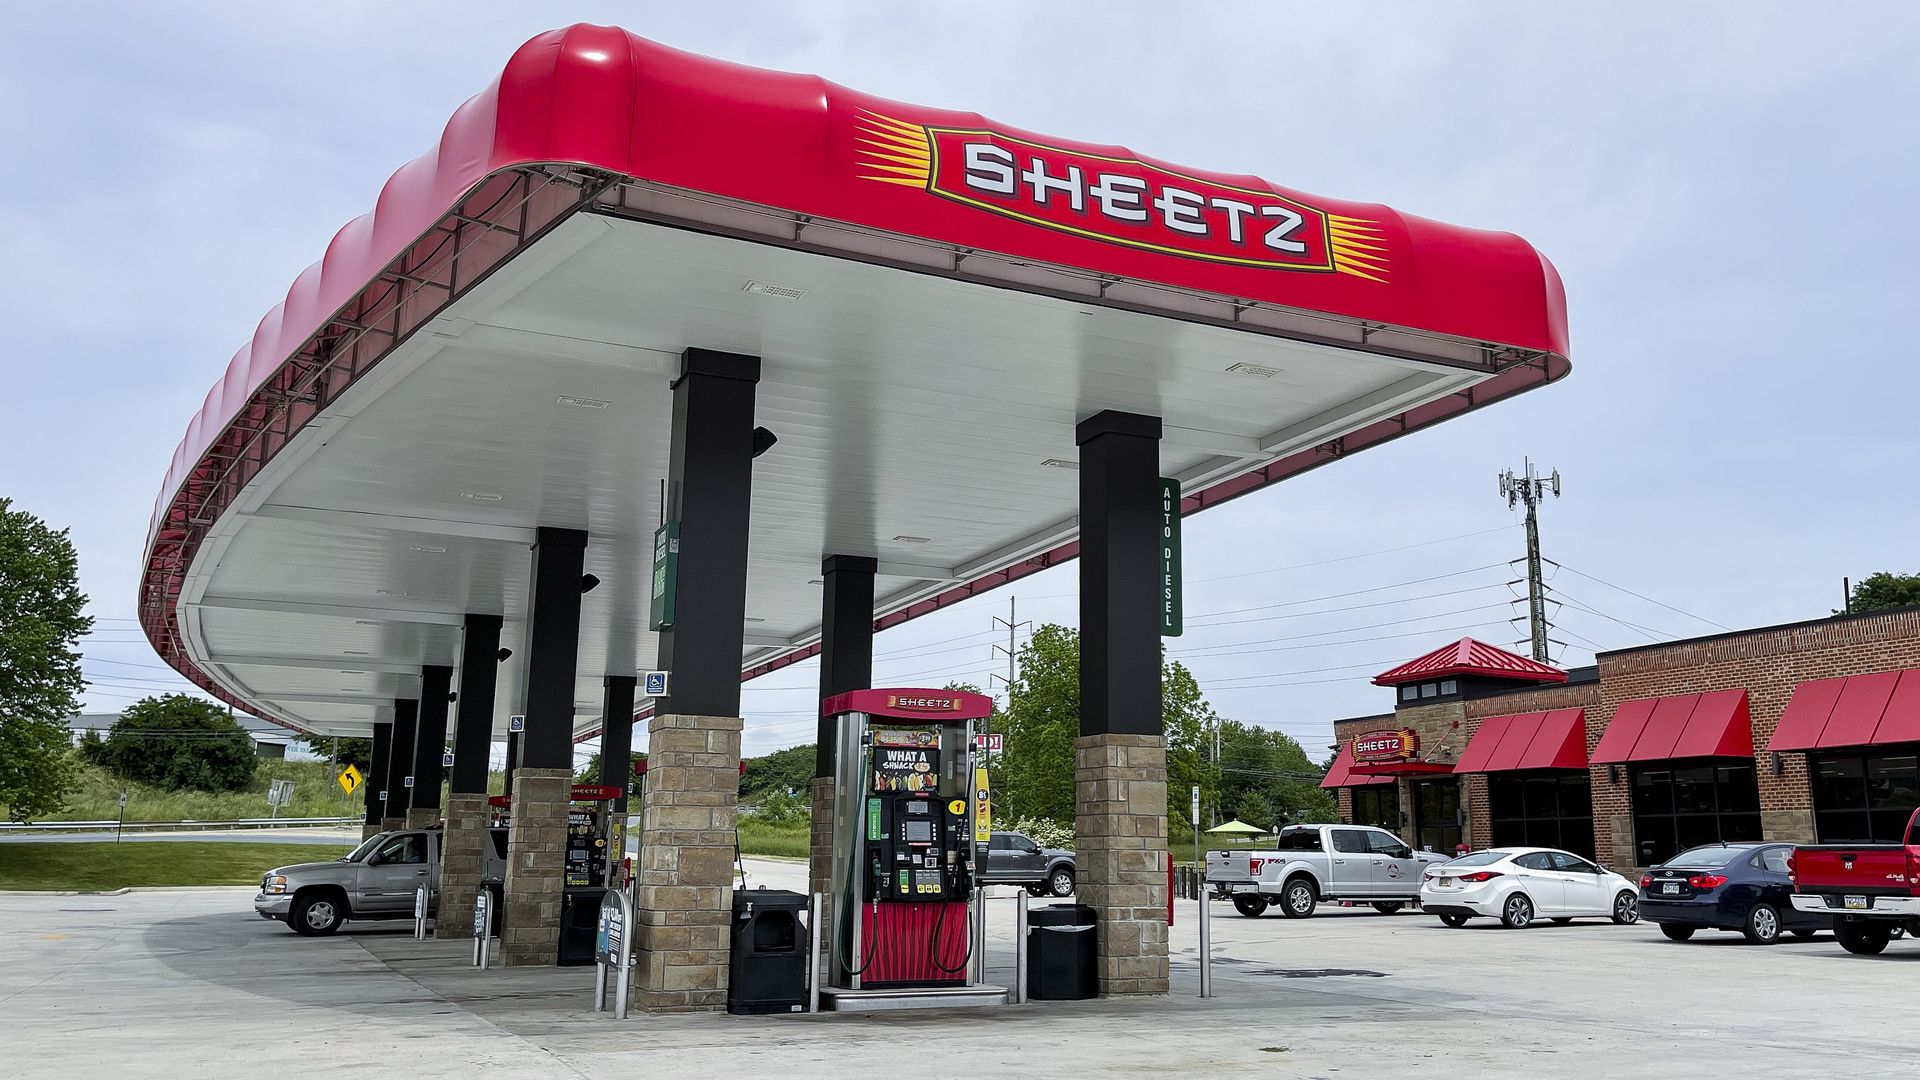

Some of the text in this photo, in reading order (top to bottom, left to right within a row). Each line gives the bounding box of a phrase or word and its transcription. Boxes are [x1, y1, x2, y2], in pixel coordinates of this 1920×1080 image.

[964, 143, 1307, 255] SHEETZ
[1163, 487, 1172, 626] AUTO DIESEL
[899, 698, 951, 708] SHEETZ
[1357, 739, 1399, 752] SHEETZ
[887, 750, 927, 762] WHAT A
[955, 803, 961, 813] 1
